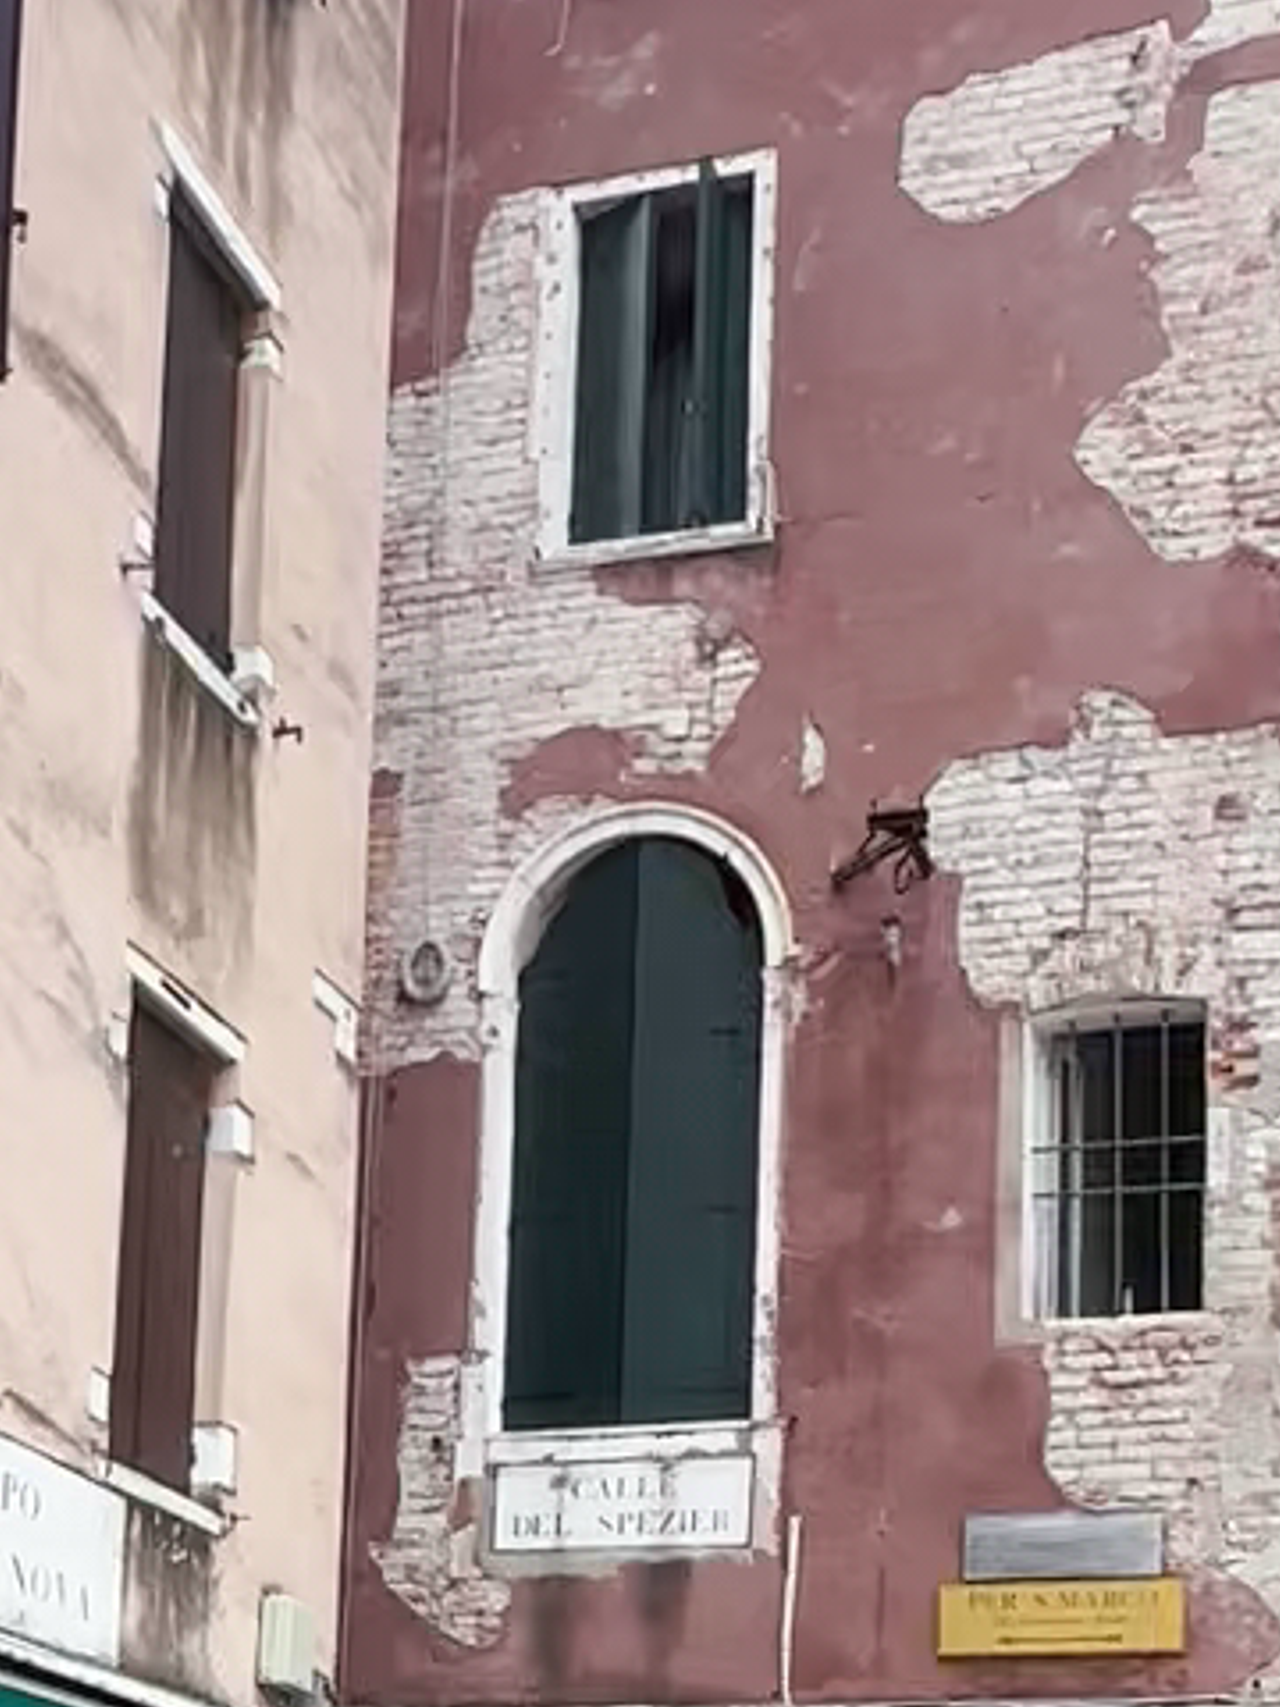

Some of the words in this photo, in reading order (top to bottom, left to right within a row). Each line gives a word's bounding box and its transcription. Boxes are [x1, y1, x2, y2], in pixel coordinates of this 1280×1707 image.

[571, 1475, 677, 1499] CALLE
[512, 1512, 573, 1538] DEL
[596, 1508, 729, 1536] SPEZIER
[10, 1554, 90, 1622] NOVA
